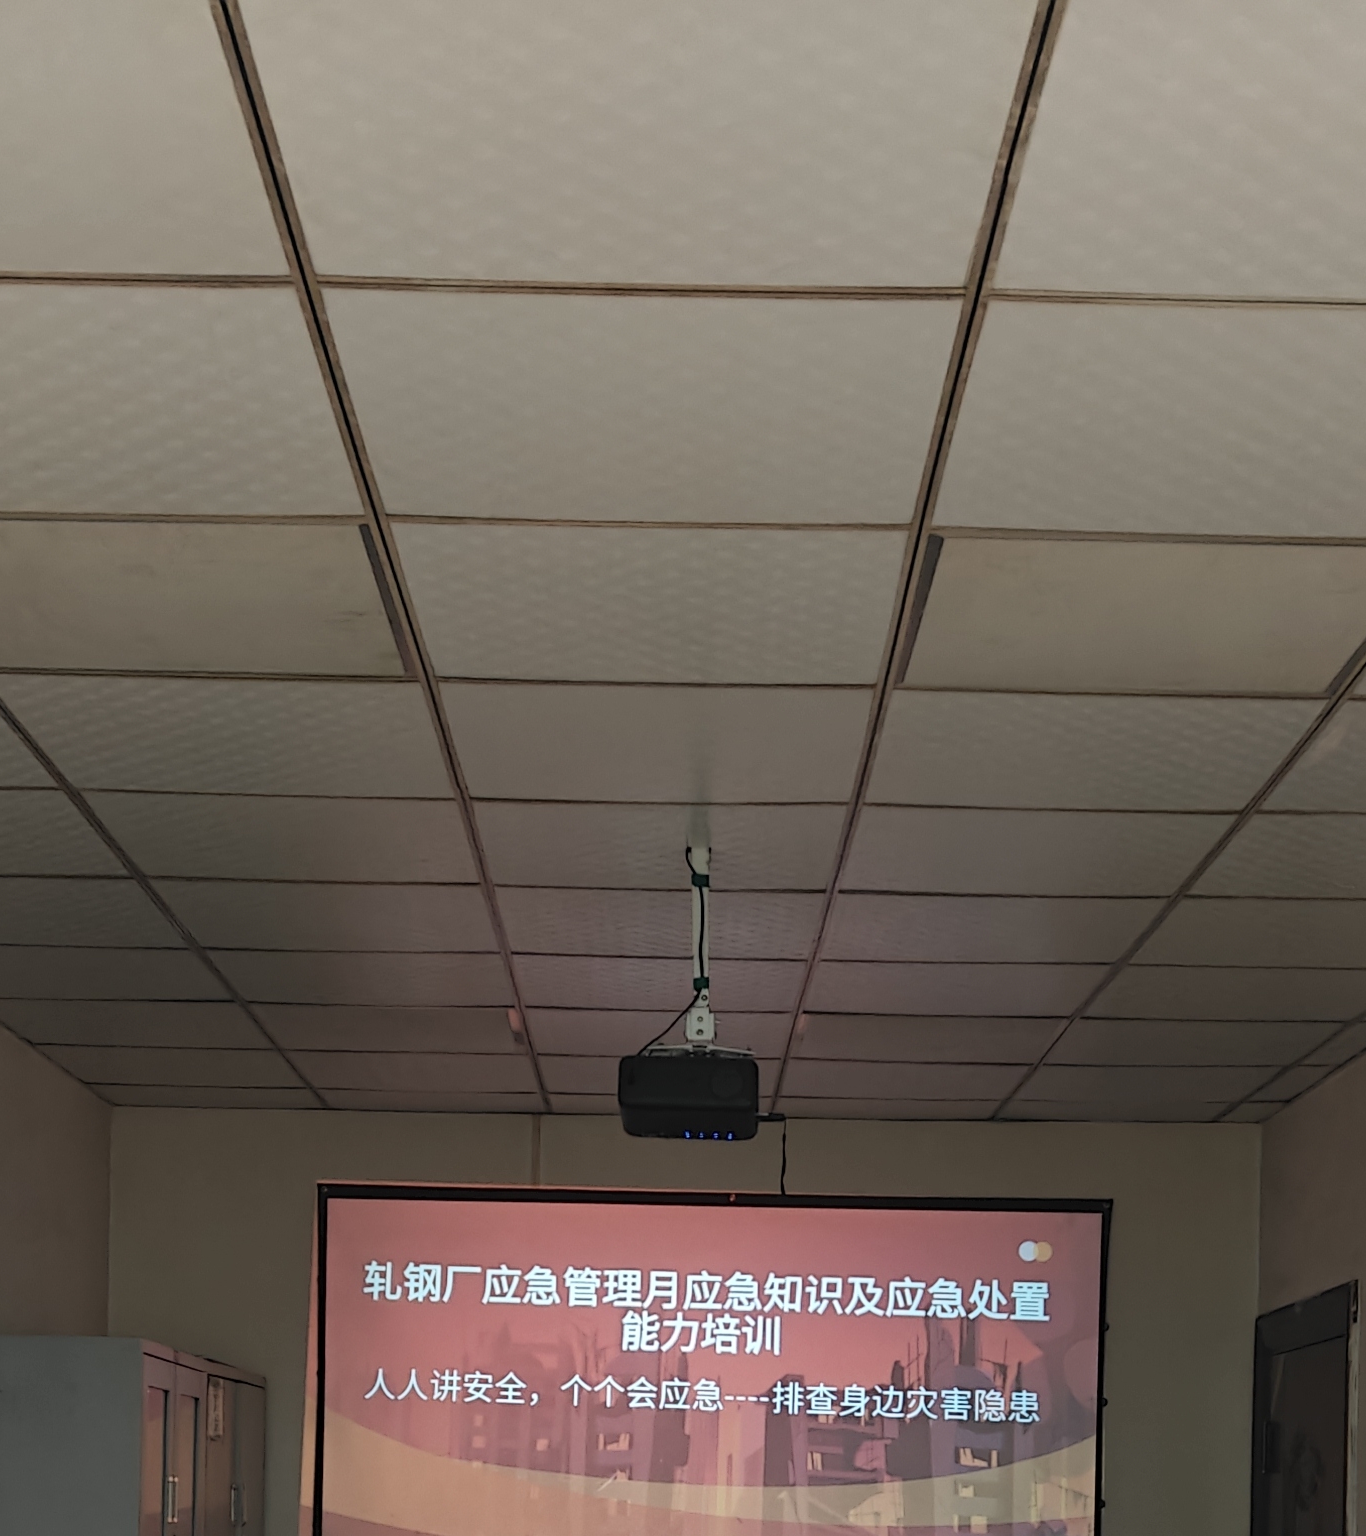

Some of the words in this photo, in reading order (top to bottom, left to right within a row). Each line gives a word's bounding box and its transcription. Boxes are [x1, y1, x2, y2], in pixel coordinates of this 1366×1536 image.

[363, 1259, 1051, 1323] 轧钢厂应急管理月应急知识及应急处置
[620, 1310, 782, 1356] 能力培训
